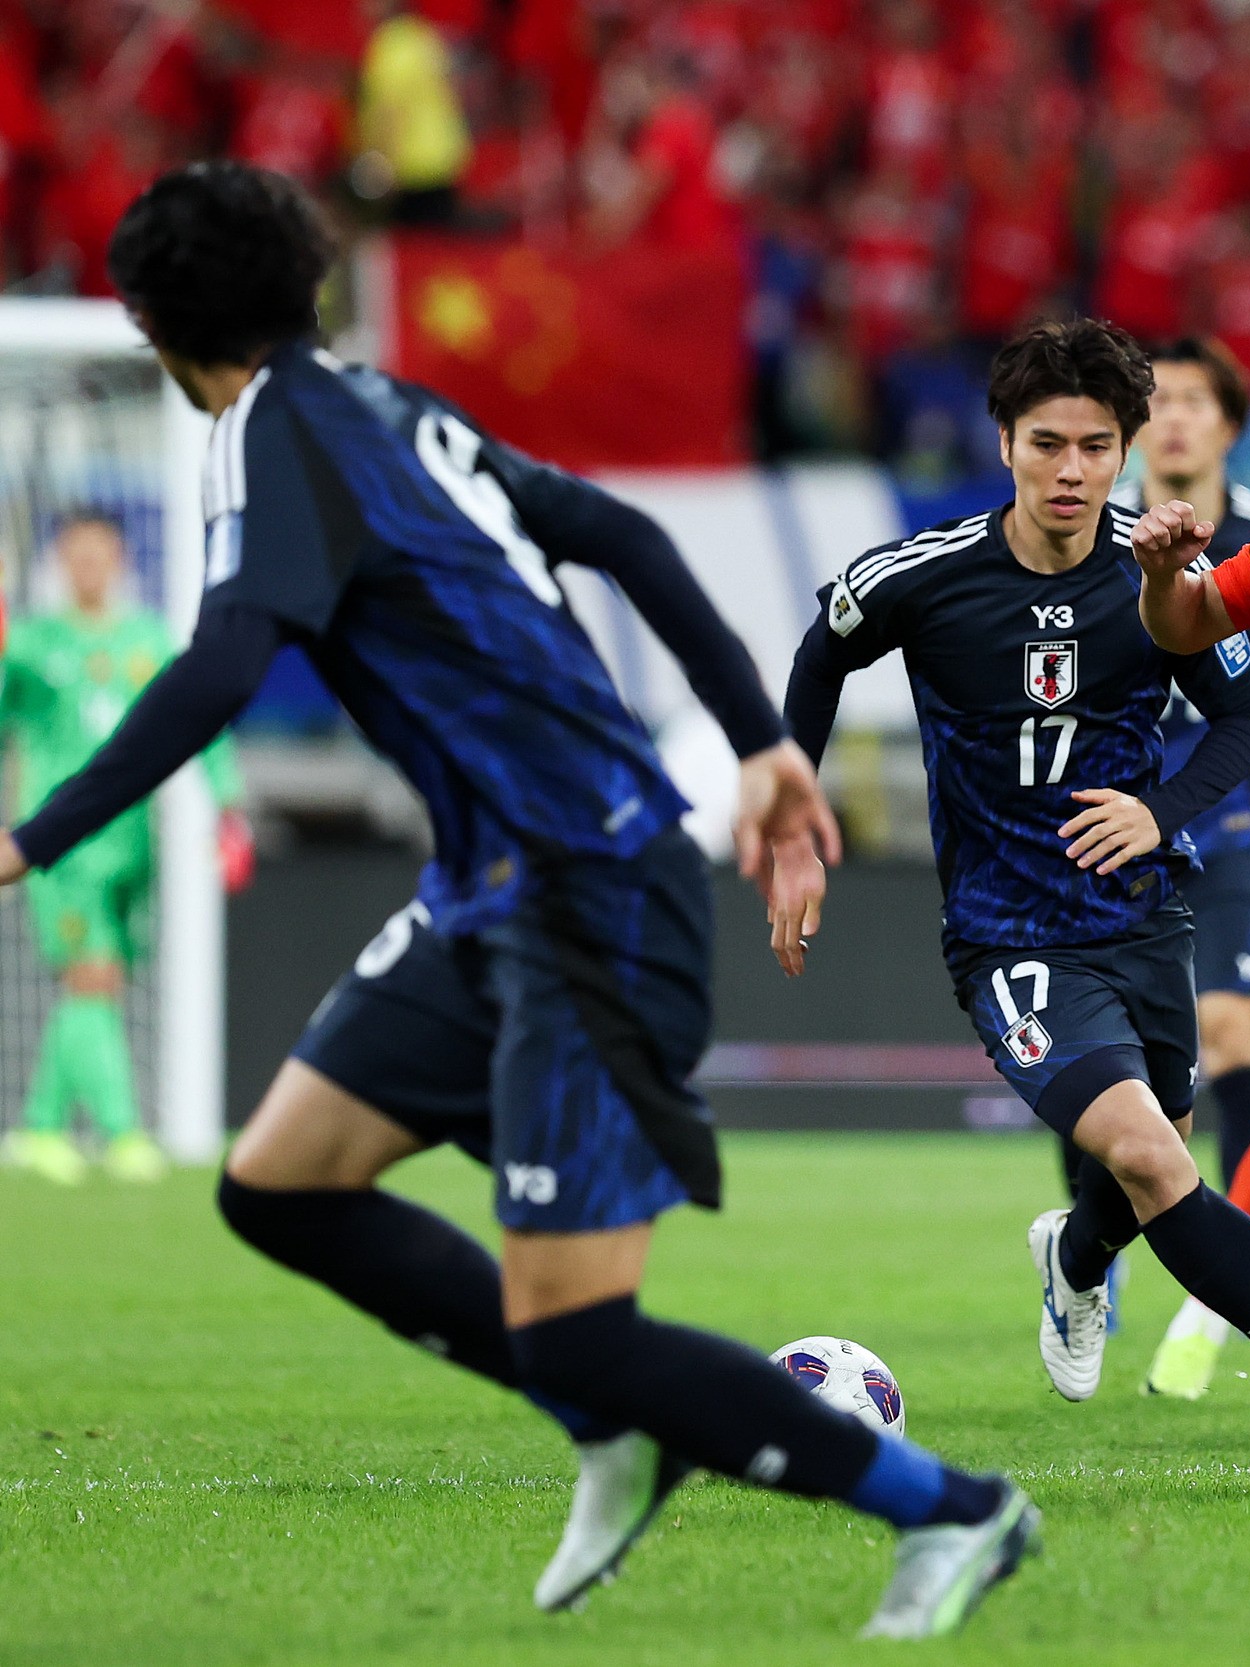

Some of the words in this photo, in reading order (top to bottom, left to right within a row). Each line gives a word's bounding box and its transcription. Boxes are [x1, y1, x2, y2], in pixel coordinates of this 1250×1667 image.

[1030, 605, 1075, 630] Y-3
[1038, 643, 1066, 651] JAPAN
[1039, 686, 1062, 696] JFA
[1019, 714, 1079, 787] 17
[991, 960, 1050, 1027] 17
